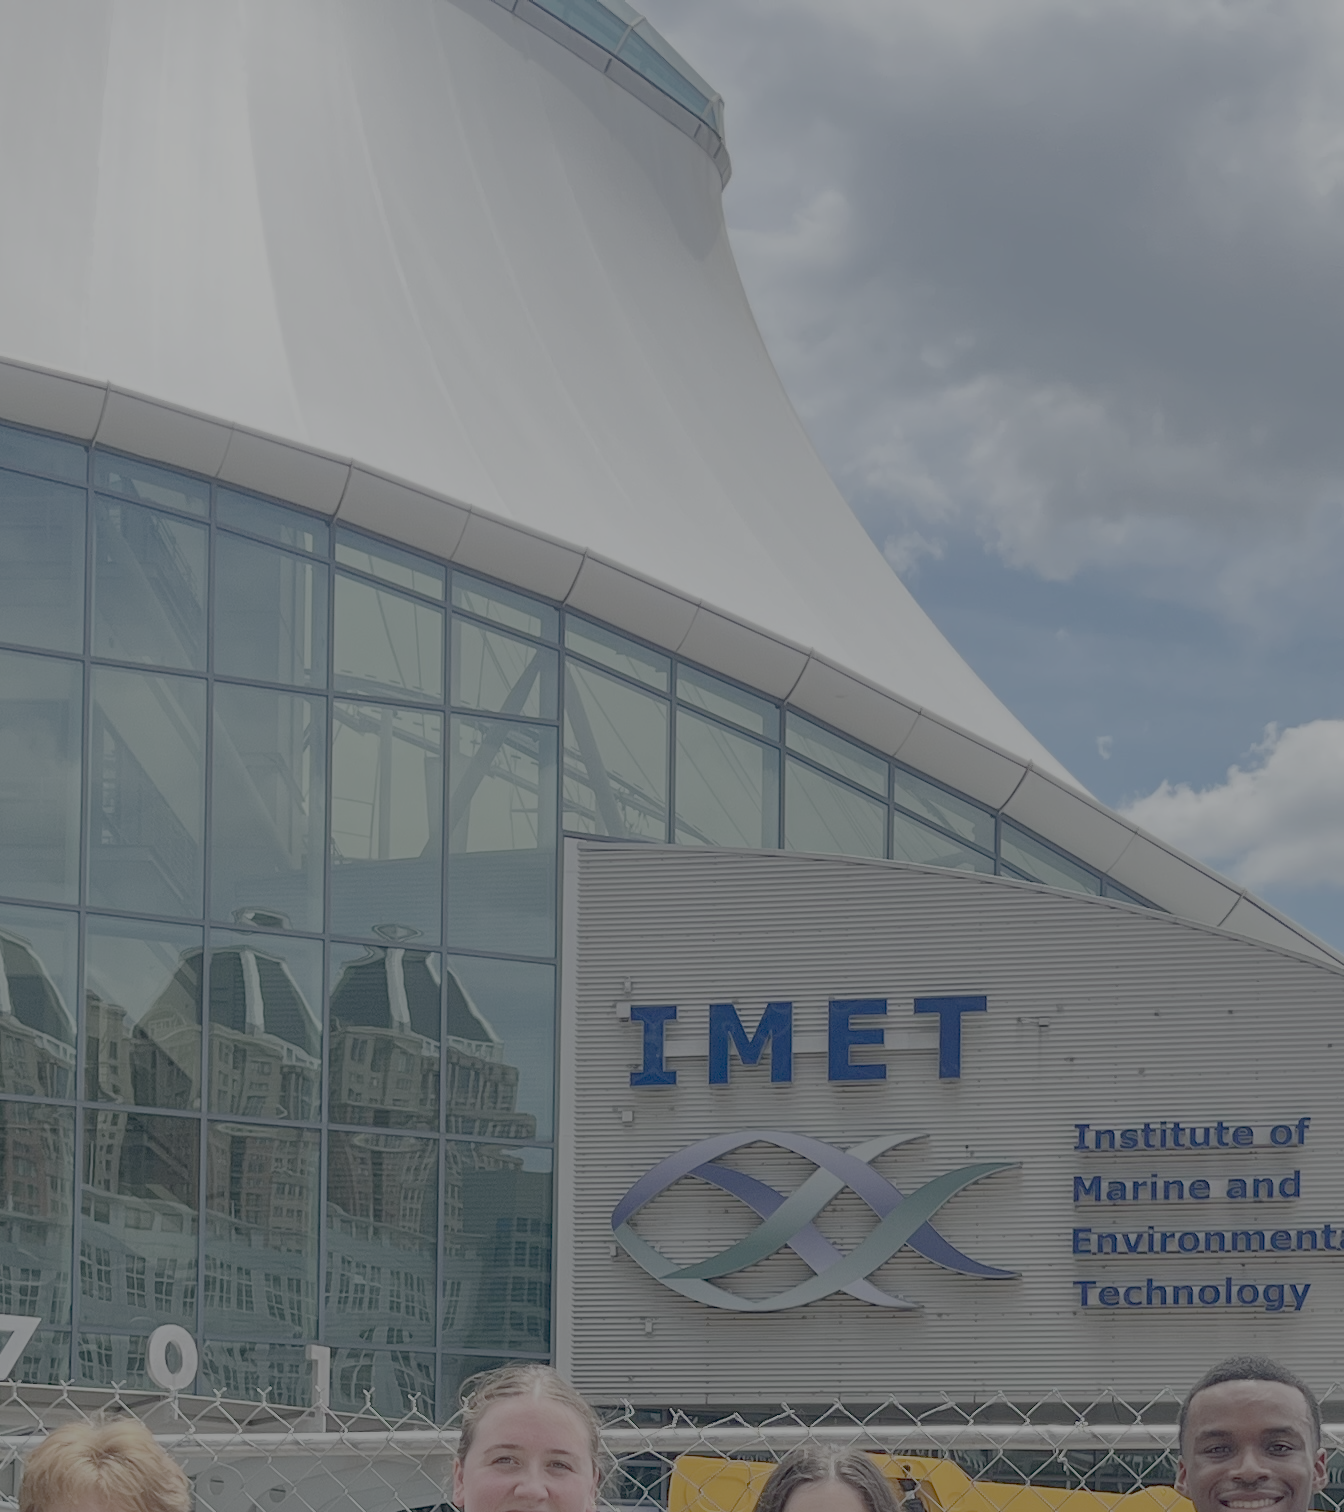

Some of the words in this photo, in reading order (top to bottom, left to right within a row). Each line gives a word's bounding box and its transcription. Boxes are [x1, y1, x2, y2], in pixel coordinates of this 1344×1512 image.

[630, 995, 988, 1087] IMET
[1073, 1119, 1254, 1150] Institute
[1269, 1117, 1311, 1147] of
[1072, 1173, 1211, 1203] Marine
[1226, 1169, 1301, 1200] and
[1072, 1277, 1312, 1311] Technology
